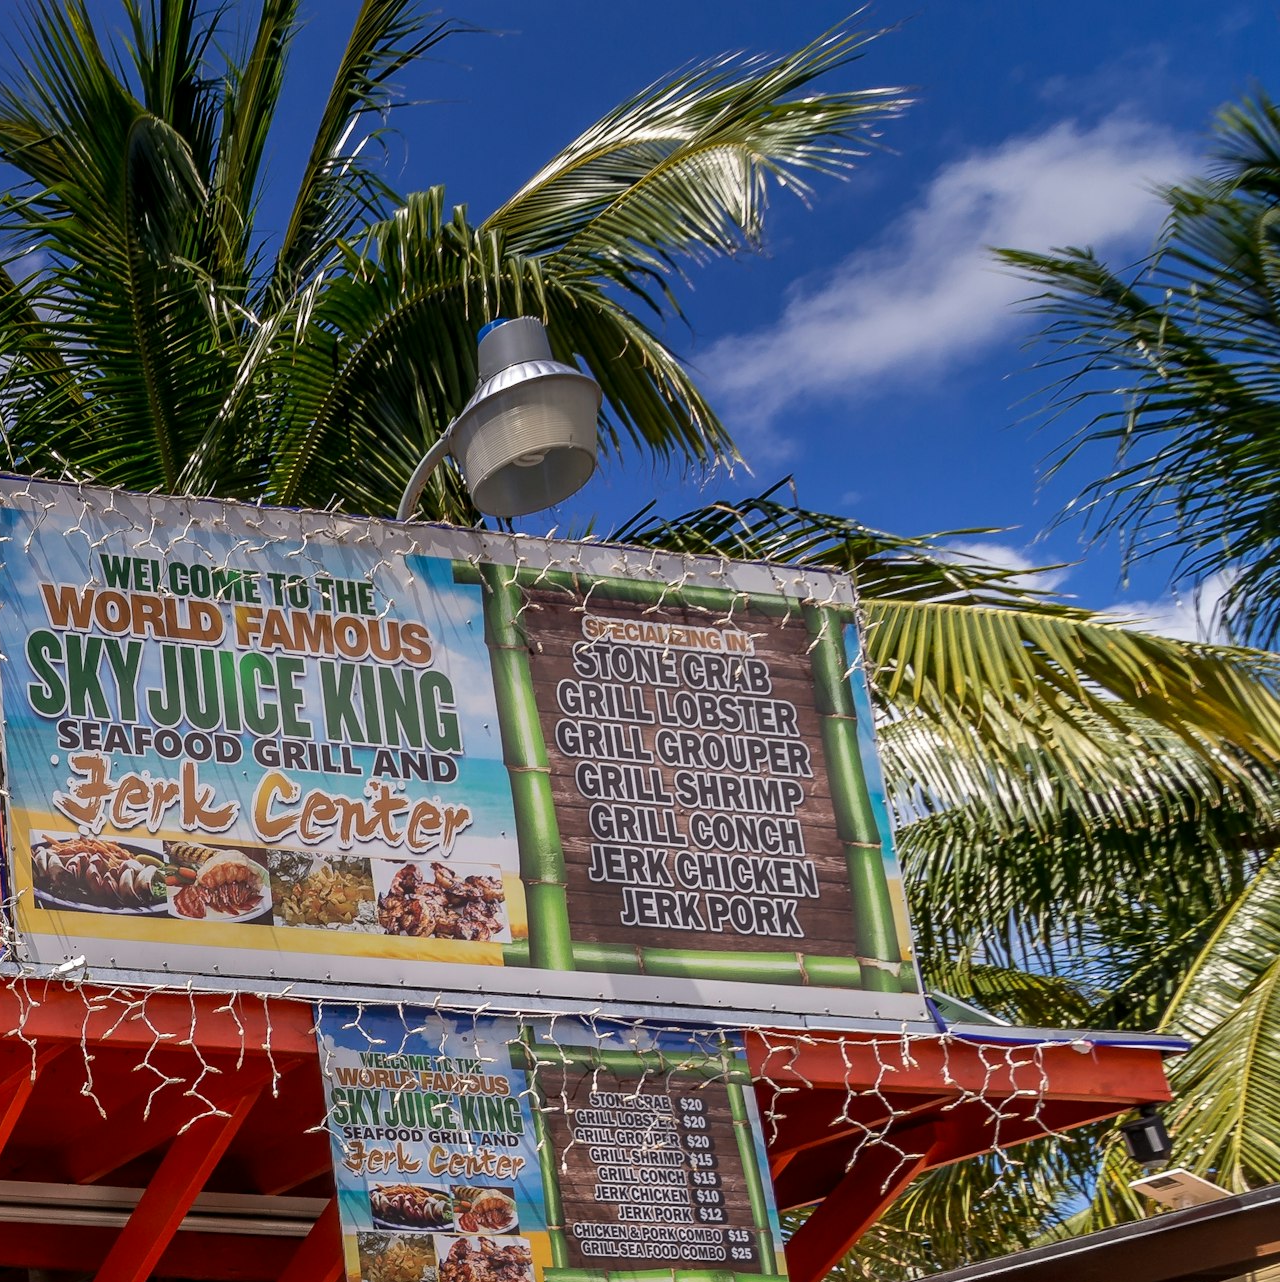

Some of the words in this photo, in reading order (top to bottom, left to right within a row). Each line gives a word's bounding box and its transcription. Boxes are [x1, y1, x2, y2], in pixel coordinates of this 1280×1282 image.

[99, 553, 262, 604] WELCOME
[267, 572, 309, 609] TO
[315, 577, 376, 615] THE
[41, 583, 223, 642] WORLD
[234, 605, 432, 664] FAMOUS
[585, 619, 721, 650] SPECIALIZING
[574, 643, 678, 685] STONE
[682, 654, 770, 694] CRAB
[28, 631, 142, 722] SKY
[146, 642, 314, 739] JUICE
[320, 660, 463, 754] KING
[558, 682, 653, 723] GRILL
[658, 692, 799, 737] LOBSTER
[58, 720, 241, 764] SEAFOOD
[255, 737, 361, 775] GRILL
[372, 749, 458, 783] AND
[557, 720, 651, 762] GRILL
[657, 731, 813, 777] GROUPER
[56, 754, 235, 833] Jerk
[255, 772, 472, 856] Center
[577, 763, 673, 804] GRILL
[677, 771, 803, 816] SHRIMP
[590, 805, 687, 846] GRILL
[691, 814, 804, 855] CONCH
[589, 844, 671, 887] JERK
[675, 854, 819, 898] CHICKEN
[621, 889, 706, 930] JERK
[710, 897, 804, 937] PORK
[336, 1068, 416, 1090] WORLD
[420, 1073, 510, 1096] FAMOUS
[360, 1053, 431, 1070] WELCOME
[434, 1057, 452, 1071] TO
[456, 1059, 483, 1074] THE
[330, 1088, 381, 1126] SKY
[385, 1091, 458, 1129] JUICE
[460, 1096, 524, 1133] KING
[576, 1109, 616, 1125] GRILL
[617, 1111, 676, 1129] LOBSTER
[683, 1115, 706, 1128] $20
[589, 1093, 633, 1109] STONE
[636, 1095, 671, 1110] CRAB
[680, 1098, 702, 1111] $20
[343, 1127, 423, 1142] SEAFOOD
[428, 1131, 476, 1145] GRILL
[481, 1134, 519, 1147] AND
[574, 1127, 615, 1144] GRILL
[616, 1130, 679, 1148] GROUPER
[687, 1135, 709, 1148] $20
[344, 1140, 421, 1172] Jerk
[428, 1146, 525, 1179] Center
[589, 1147, 631, 1164] GRILL
[631, 1150, 684, 1167] SHRIMP
[690, 1154, 713, 1167] $15
[598, 1167, 638, 1183] GRILL
[640, 1169, 687, 1186] CONCH
[694, 1172, 717, 1185] $15
[595, 1184, 629, 1201] JERK
[631, 1186, 691, 1204] CHICKEN
[696, 1190, 720, 1203] $10
[618, 1204, 654, 1221] JERK
[655, 1207, 694, 1223] PORK
[700, 1208, 723, 1221] $12
[573, 1223, 628, 1239] CHICKEN
[629, 1226, 641, 1240] &
[641, 1226, 677, 1242] PORK
[678, 1228, 723, 1244] COMBO
[728, 1230, 749, 1242] $15
[581, 1242, 619, 1257] GRILL
[645, 1245, 681, 1260] FOOD
[682, 1246, 727, 1261] COMBO
[731, 1248, 752, 1260] $25
